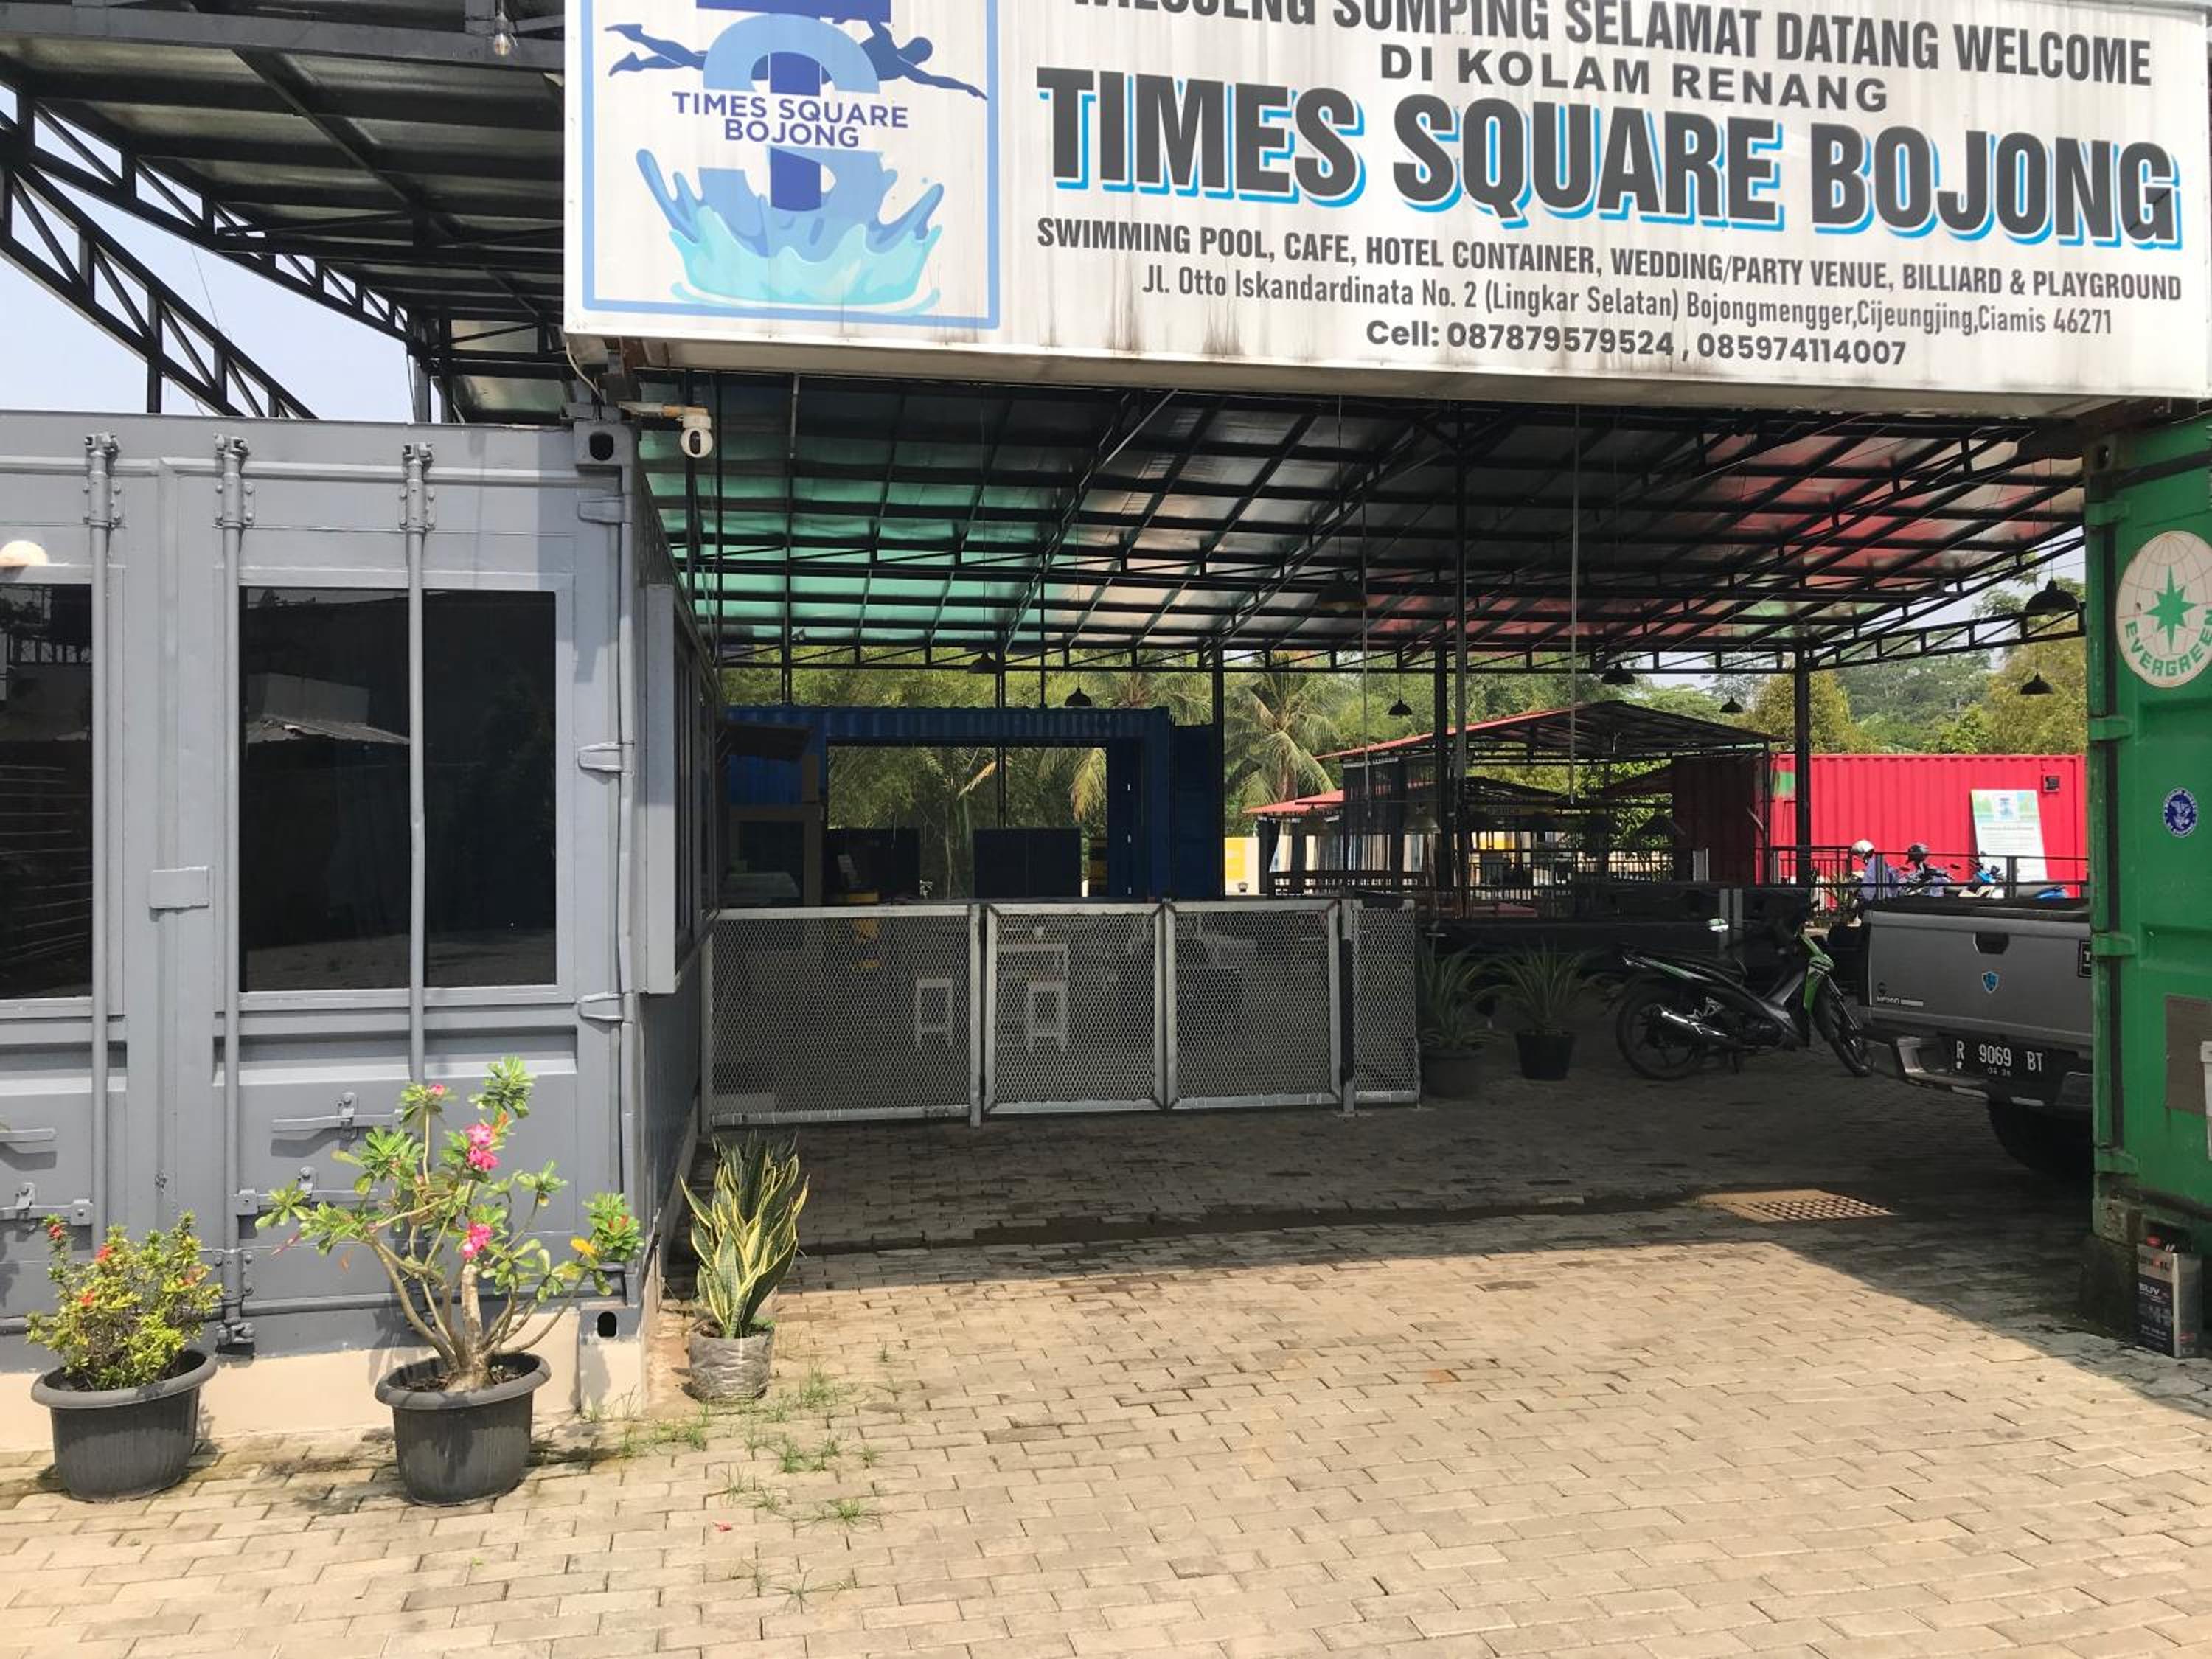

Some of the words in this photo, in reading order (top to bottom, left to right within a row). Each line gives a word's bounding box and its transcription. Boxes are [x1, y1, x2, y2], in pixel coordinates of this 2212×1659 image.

[1333, 0, 1548, 40] SUMPING
[1565, 0, 1761, 58] SELAMAT
[1776, 11, 1939, 70] DATANG
[1955, 23, 2152, 86] WELCOME
[1381, 43, 1433, 82] DI
[1458, 47, 1649, 94] KOLAM
[1672, 63, 1888, 112] RENANG
[672, 92, 768, 119] TIMES
[779, 99, 908, 128] SQUARE
[724, 119, 860, 148] BOJONG
[1037, 67, 1366, 207] TIMES
[1393, 94, 1784, 231] SQUARE
[1811, 122, 2183, 250] BOJONG
[1037, 218, 1190, 254] SWIMMING
[1200, 226, 1275, 262] POOL,
[1284, 232, 1356, 266] CAFE,
[1366, 236, 1444, 268] HOTEL
[1453, 240, 1602, 277] CONTAINER,
[1610, 248, 1804, 285] WEDDING/PARTY
[1811, 260, 1894, 292] VENUE,
[1903, 264, 2002, 294] BILLIARD
[2010, 269, 2025, 295] &
[2033, 271, 2182, 300] PLAYGROUND
[1142, 265, 1170, 293] Jl.
[1179, 266, 1227, 296] Otto
[1236, 269, 1413, 305] Iskandardinata
[1422, 279, 1456, 307] No.
[1464, 281, 1477, 307] 2
[1486, 279, 1579, 318] (Lingkar
[1587, 286, 1679, 321] Selatan)
[2053, 308, 2112, 334] 46271
[1366, 320, 1439, 347] Cell:
[1447, 322, 1674, 356] 087879579524
[1697, 333, 1907, 365] 085974114007
[1956, 1040, 1965, 1060] R
[1978, 1043, 2012, 1067] 9069
[2026, 1051, 2043, 1072] BT
